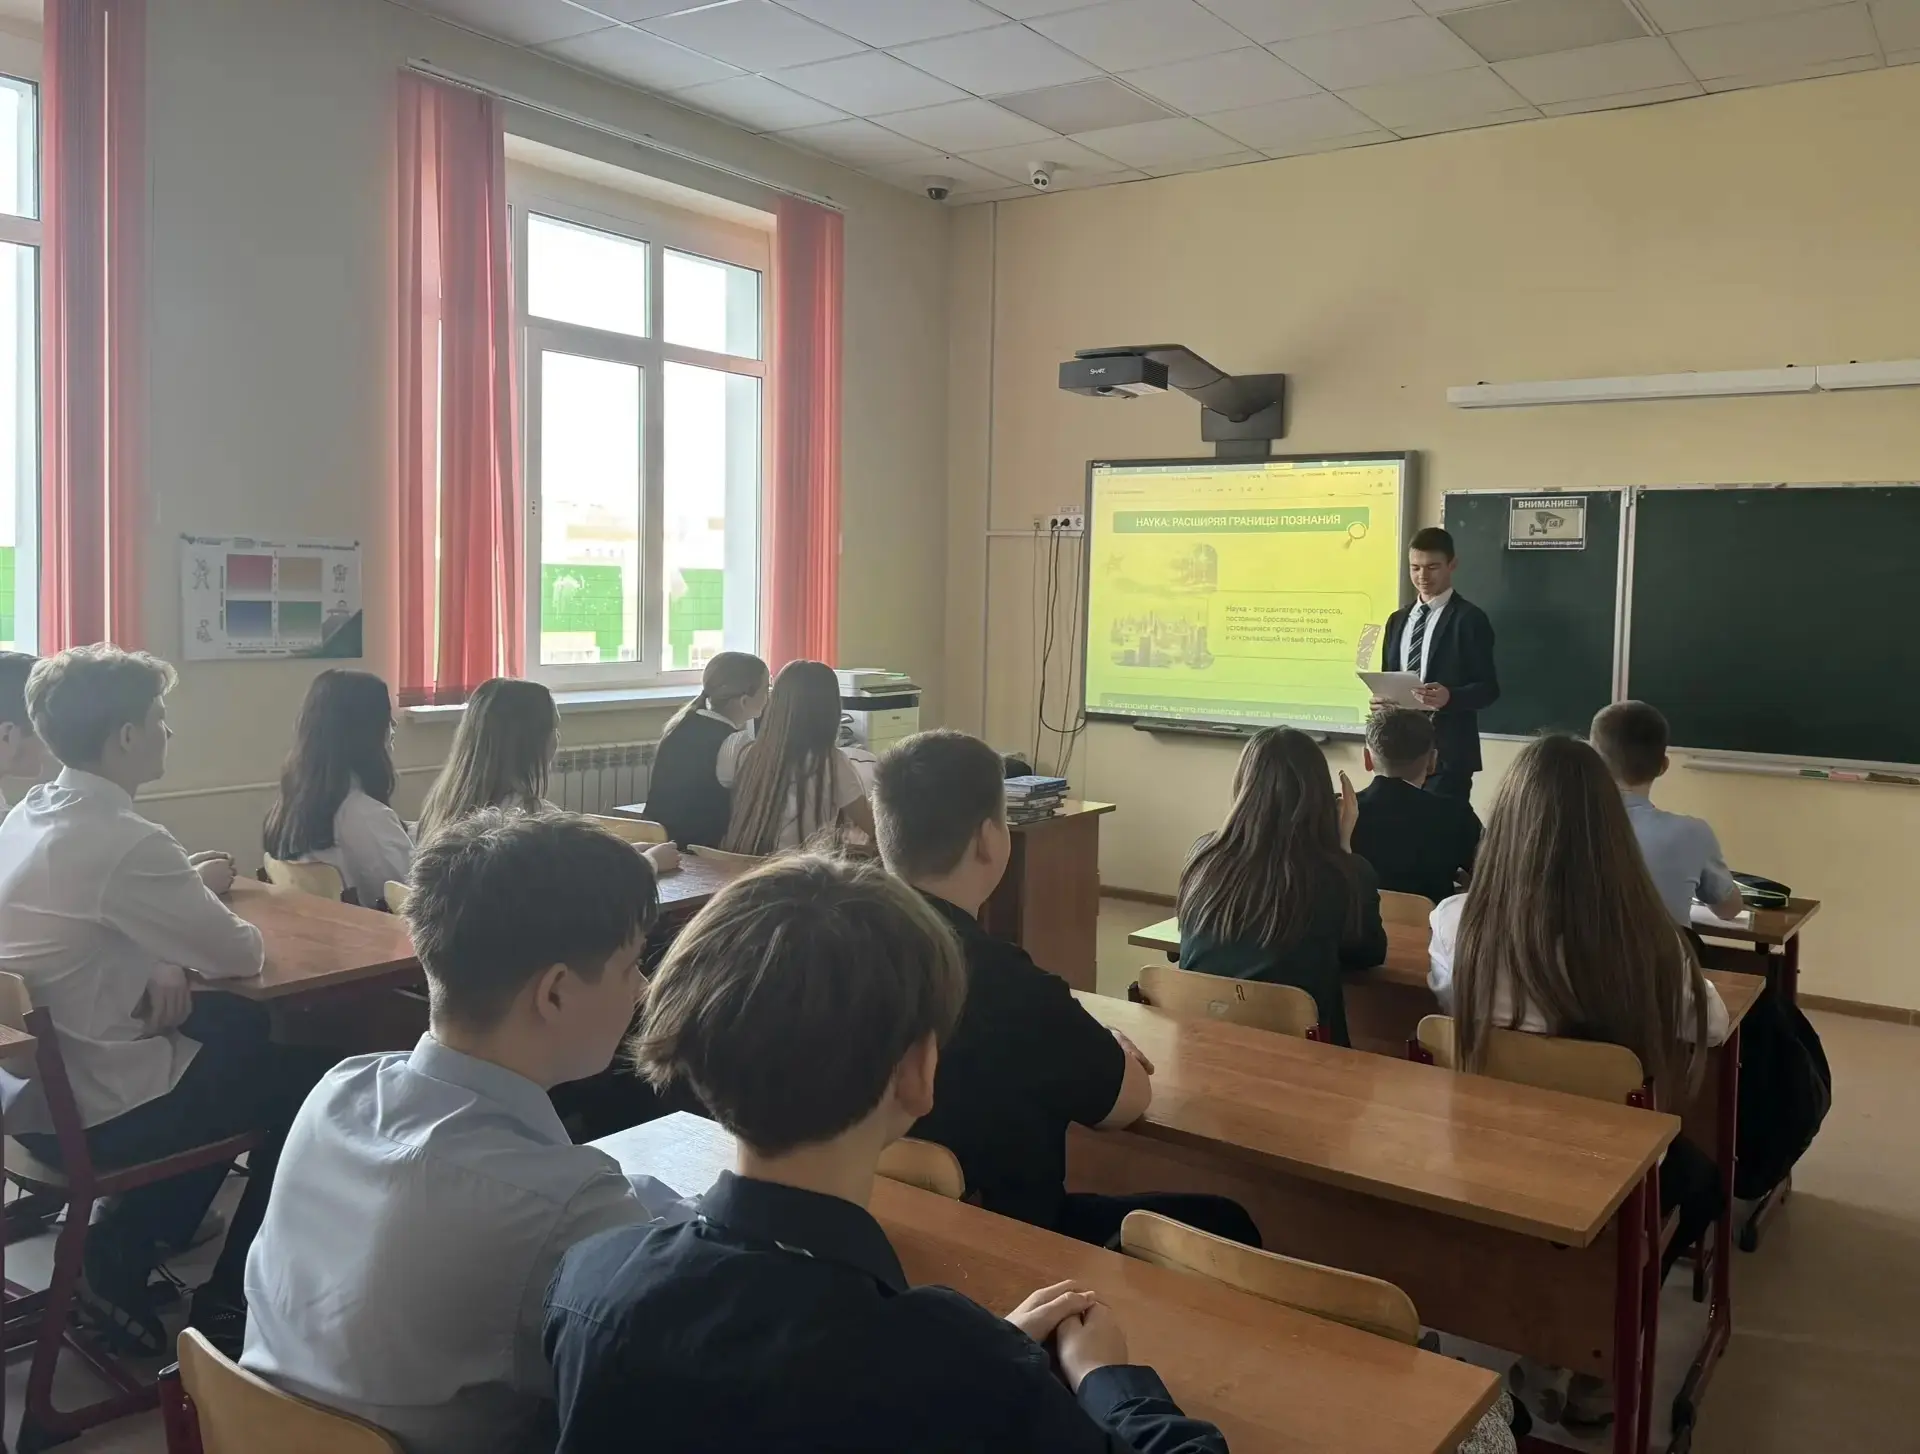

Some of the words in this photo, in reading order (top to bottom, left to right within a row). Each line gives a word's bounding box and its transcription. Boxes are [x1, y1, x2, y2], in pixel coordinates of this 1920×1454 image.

[1518, 499, 1578, 509] ВНИМАНИЕ!!!
[1136, 516, 1170, 527] НАУКА:
[1172, 516, 1227, 527] РАСШИРЯЯ
[1228, 515, 1279, 527] ГРАНИЦЫ
[1281, 514, 1341, 525] ПОЗНАНИЯ
[1225, 605, 1247, 613] Наука
